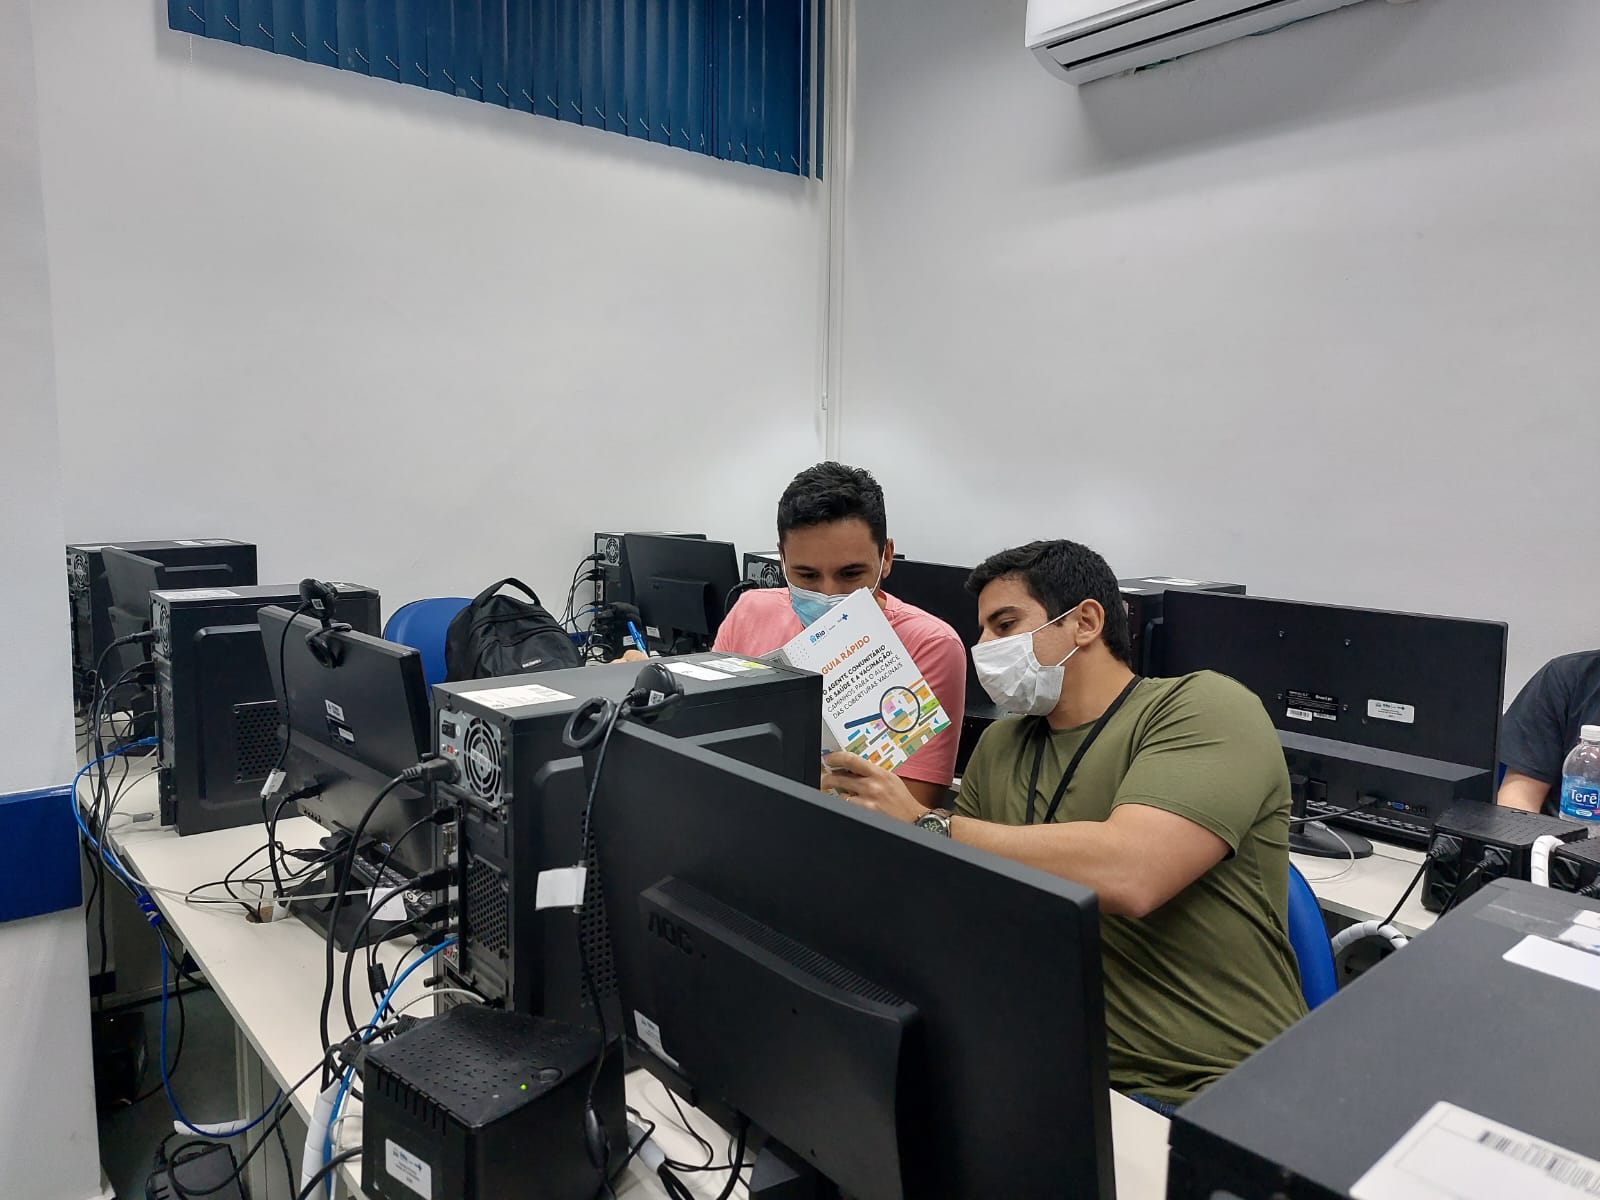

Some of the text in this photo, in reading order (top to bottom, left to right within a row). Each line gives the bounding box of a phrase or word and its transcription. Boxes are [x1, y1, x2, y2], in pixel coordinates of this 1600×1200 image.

[815, 630, 826, 639] Rio
[821, 658, 842, 675] GUIA
[840, 635, 870, 661] RÁPIDO
[825, 695, 834, 703] DE
[833, 681, 851, 698] SAÚDE
[859, 650, 893, 676] VACINAÇÃO:
[827, 673, 848, 691] AGENTE
[848, 644, 886, 675] COMUNITÁRIO
[827, 688, 856, 712] CAMINHOS
[854, 678, 869, 690] PARA
[874, 654, 900, 676] ALCANCE
[832, 662, 903, 719] DAS COBERTURAS VACINAIS
